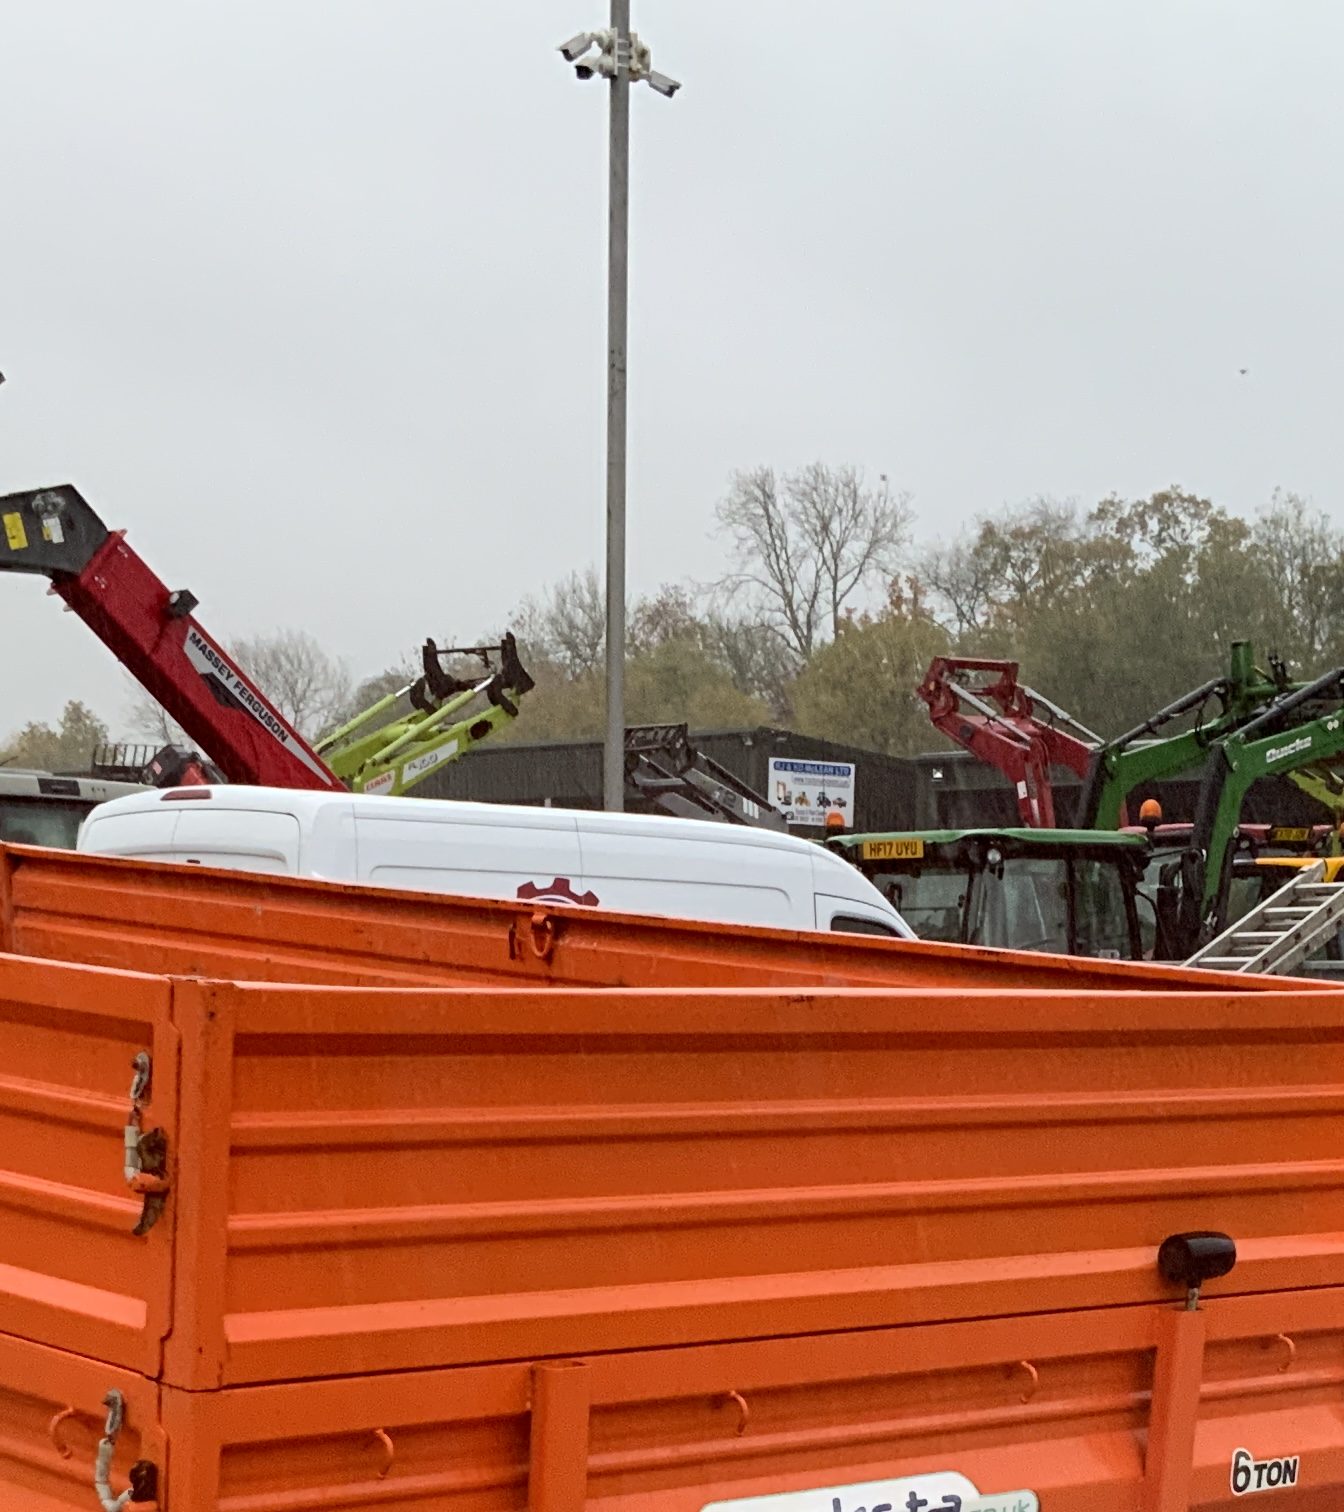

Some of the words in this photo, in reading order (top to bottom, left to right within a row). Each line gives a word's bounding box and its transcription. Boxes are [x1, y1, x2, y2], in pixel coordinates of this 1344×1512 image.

[189, 632, 234, 681] MASSEY
[233, 680, 289, 743] FERGUSON
[869, 842, 894, 857] HF17
[895, 841, 918, 856] UYU
